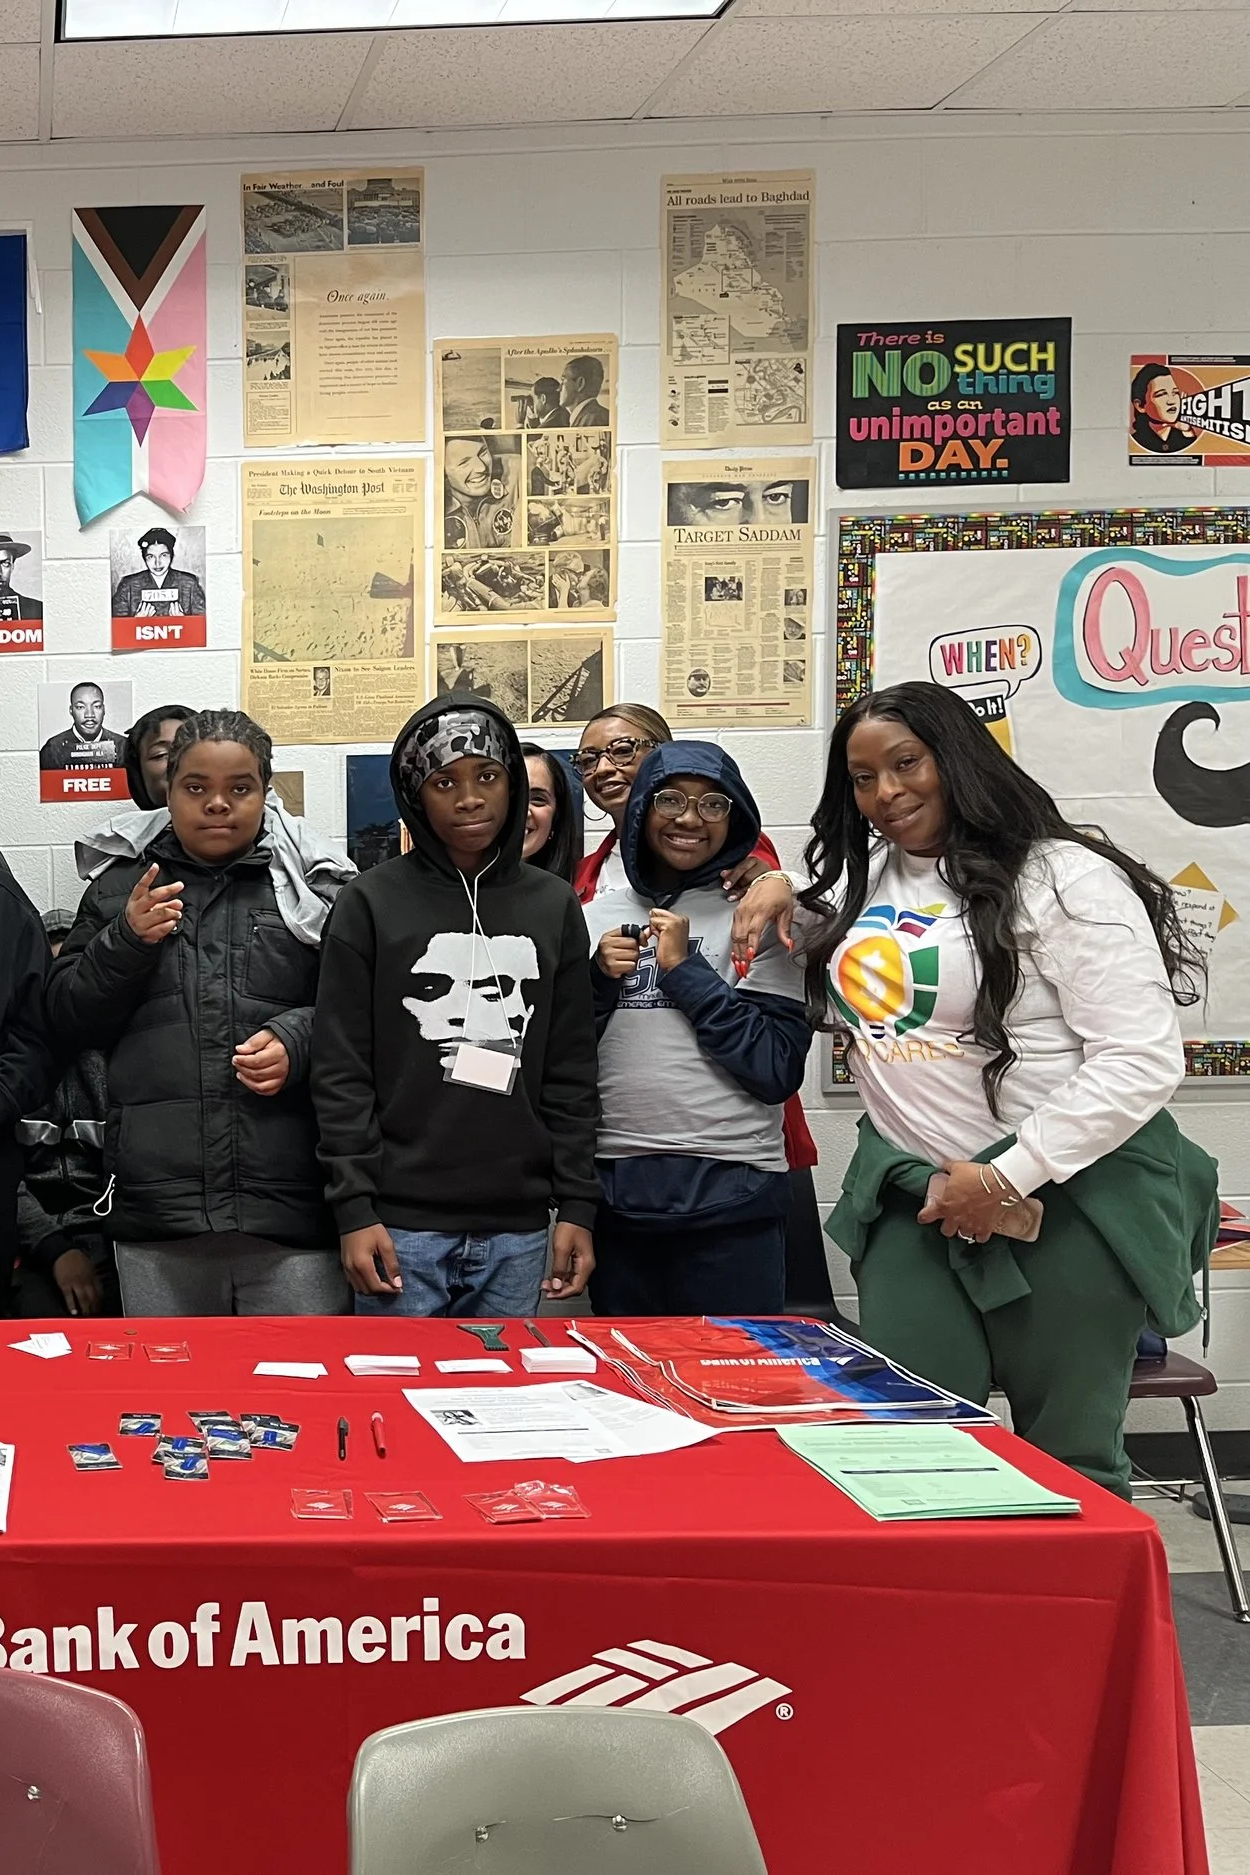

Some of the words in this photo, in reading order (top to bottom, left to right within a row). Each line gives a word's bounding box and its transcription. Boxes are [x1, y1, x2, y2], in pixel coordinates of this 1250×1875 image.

[252, 183, 266, 191] Fair
[311, 181, 325, 189] and
[667, 196, 682, 206] All
[685, 194, 716, 206] roads
[720, 193, 742, 204] lead
[746, 193, 758, 203] to
[761, 190, 810, 204] Baghdad
[327, 289, 354, 303] Once
[857, 331, 921, 346] There
[925, 330, 945, 344] is
[852, 350, 951, 398] NO
[954, 341, 1056, 374] SUCH
[957, 369, 1056, 400] thing
[927, 400, 952, 411] as
[957, 399, 983, 410] an
[850, 407, 1061, 446] unimportant
[1180, 415, 1250, 443] ANTISEMITIS
[899, 438, 1008, 472] DAY.
[248, 470, 278, 478] President
[312, 468, 332, 476] Quick
[279, 484, 298, 496] The
[300, 482, 358, 497] Washington
[362, 482, 385, 496] Post
[674, 528, 734, 543] TARGET
[738, 527, 801, 542] SADDAM
[136, 626, 183, 640] ISN'T
[940, 634, 1032, 676] WHEN?
[986, 698, 1004, 715] It!
[63, 778, 112, 792] FREE
[148, 1602, 220, 1668] of
[230, 1598, 526, 1668] America
